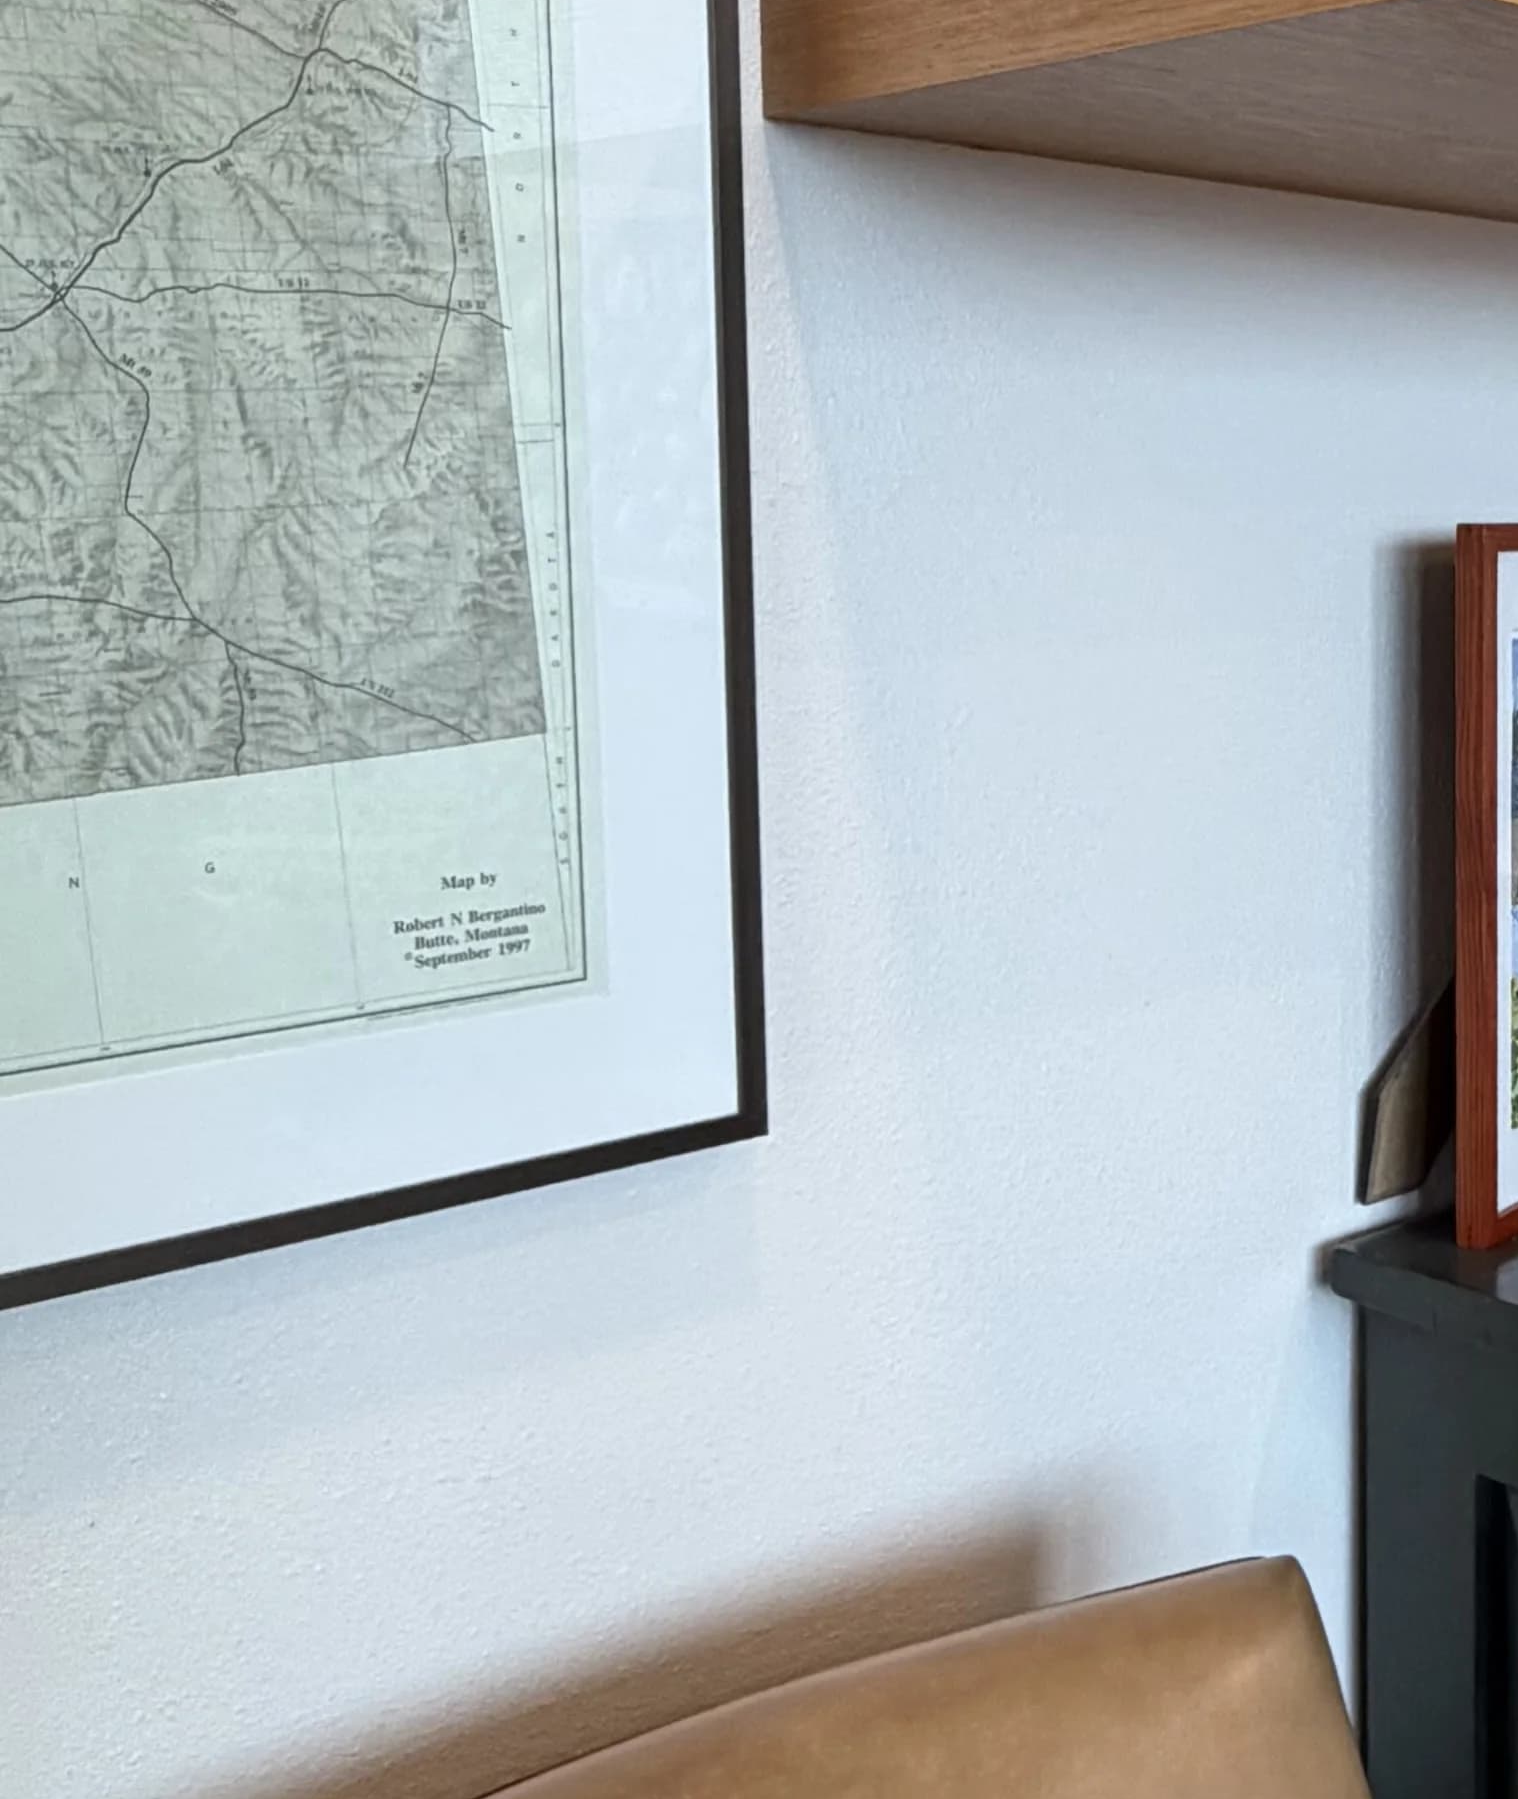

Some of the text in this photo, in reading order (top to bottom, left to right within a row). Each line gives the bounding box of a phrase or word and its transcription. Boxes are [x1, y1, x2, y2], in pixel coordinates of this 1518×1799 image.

[441, 872, 497, 892] Map by
[393, 903, 546, 934] Robert N Bergantino
[414, 923, 529, 951] Butte, Montana
[498, 939, 531, 957] 1997
